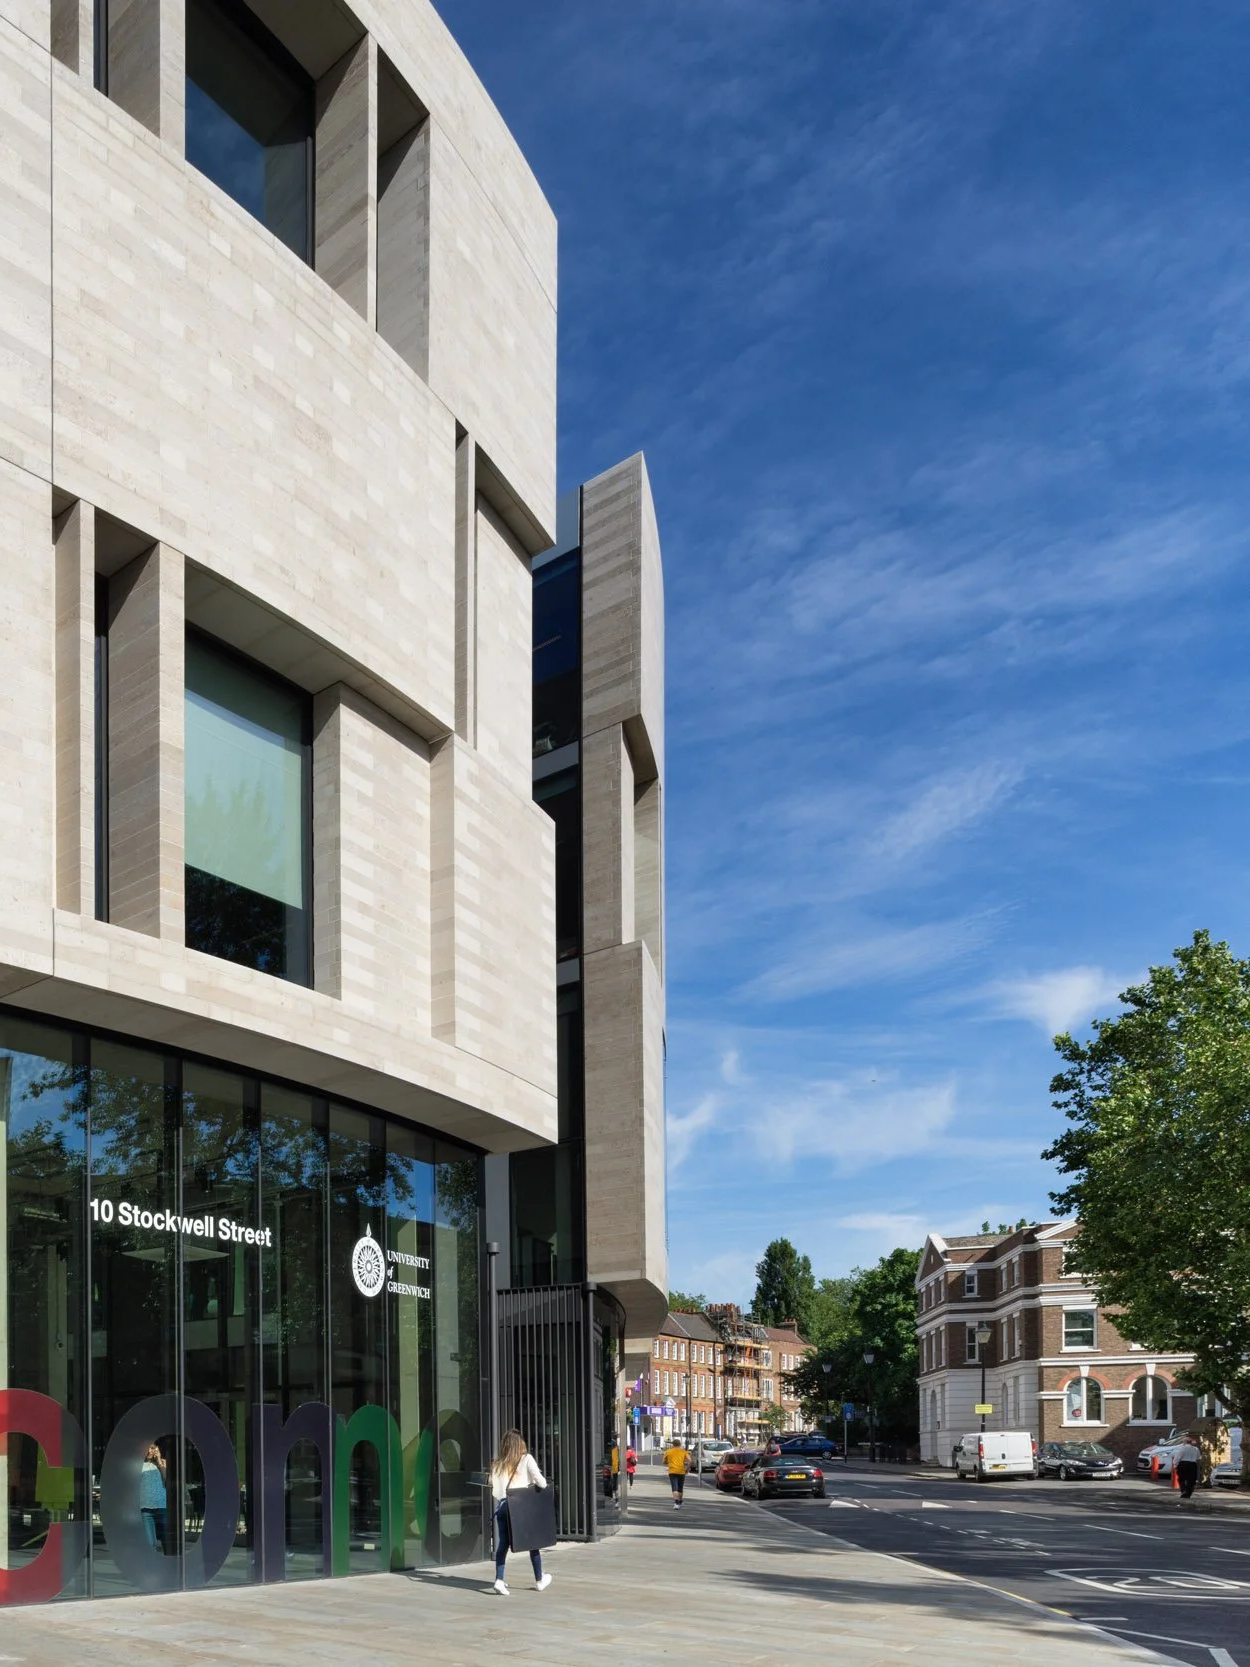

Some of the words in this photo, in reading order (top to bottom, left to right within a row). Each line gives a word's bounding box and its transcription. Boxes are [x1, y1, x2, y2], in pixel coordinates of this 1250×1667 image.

[90, 1199, 114, 1223] 10
[118, 1202, 214, 1238] Stockwell
[218, 1218, 272, 1247] Street
[387, 1250, 430, 1269] UNIVERSITY
[387, 1266, 394, 1279] of
[387, 1281, 430, 1299] GREENWICH
[1085, 1575, 1240, 1590] 20
